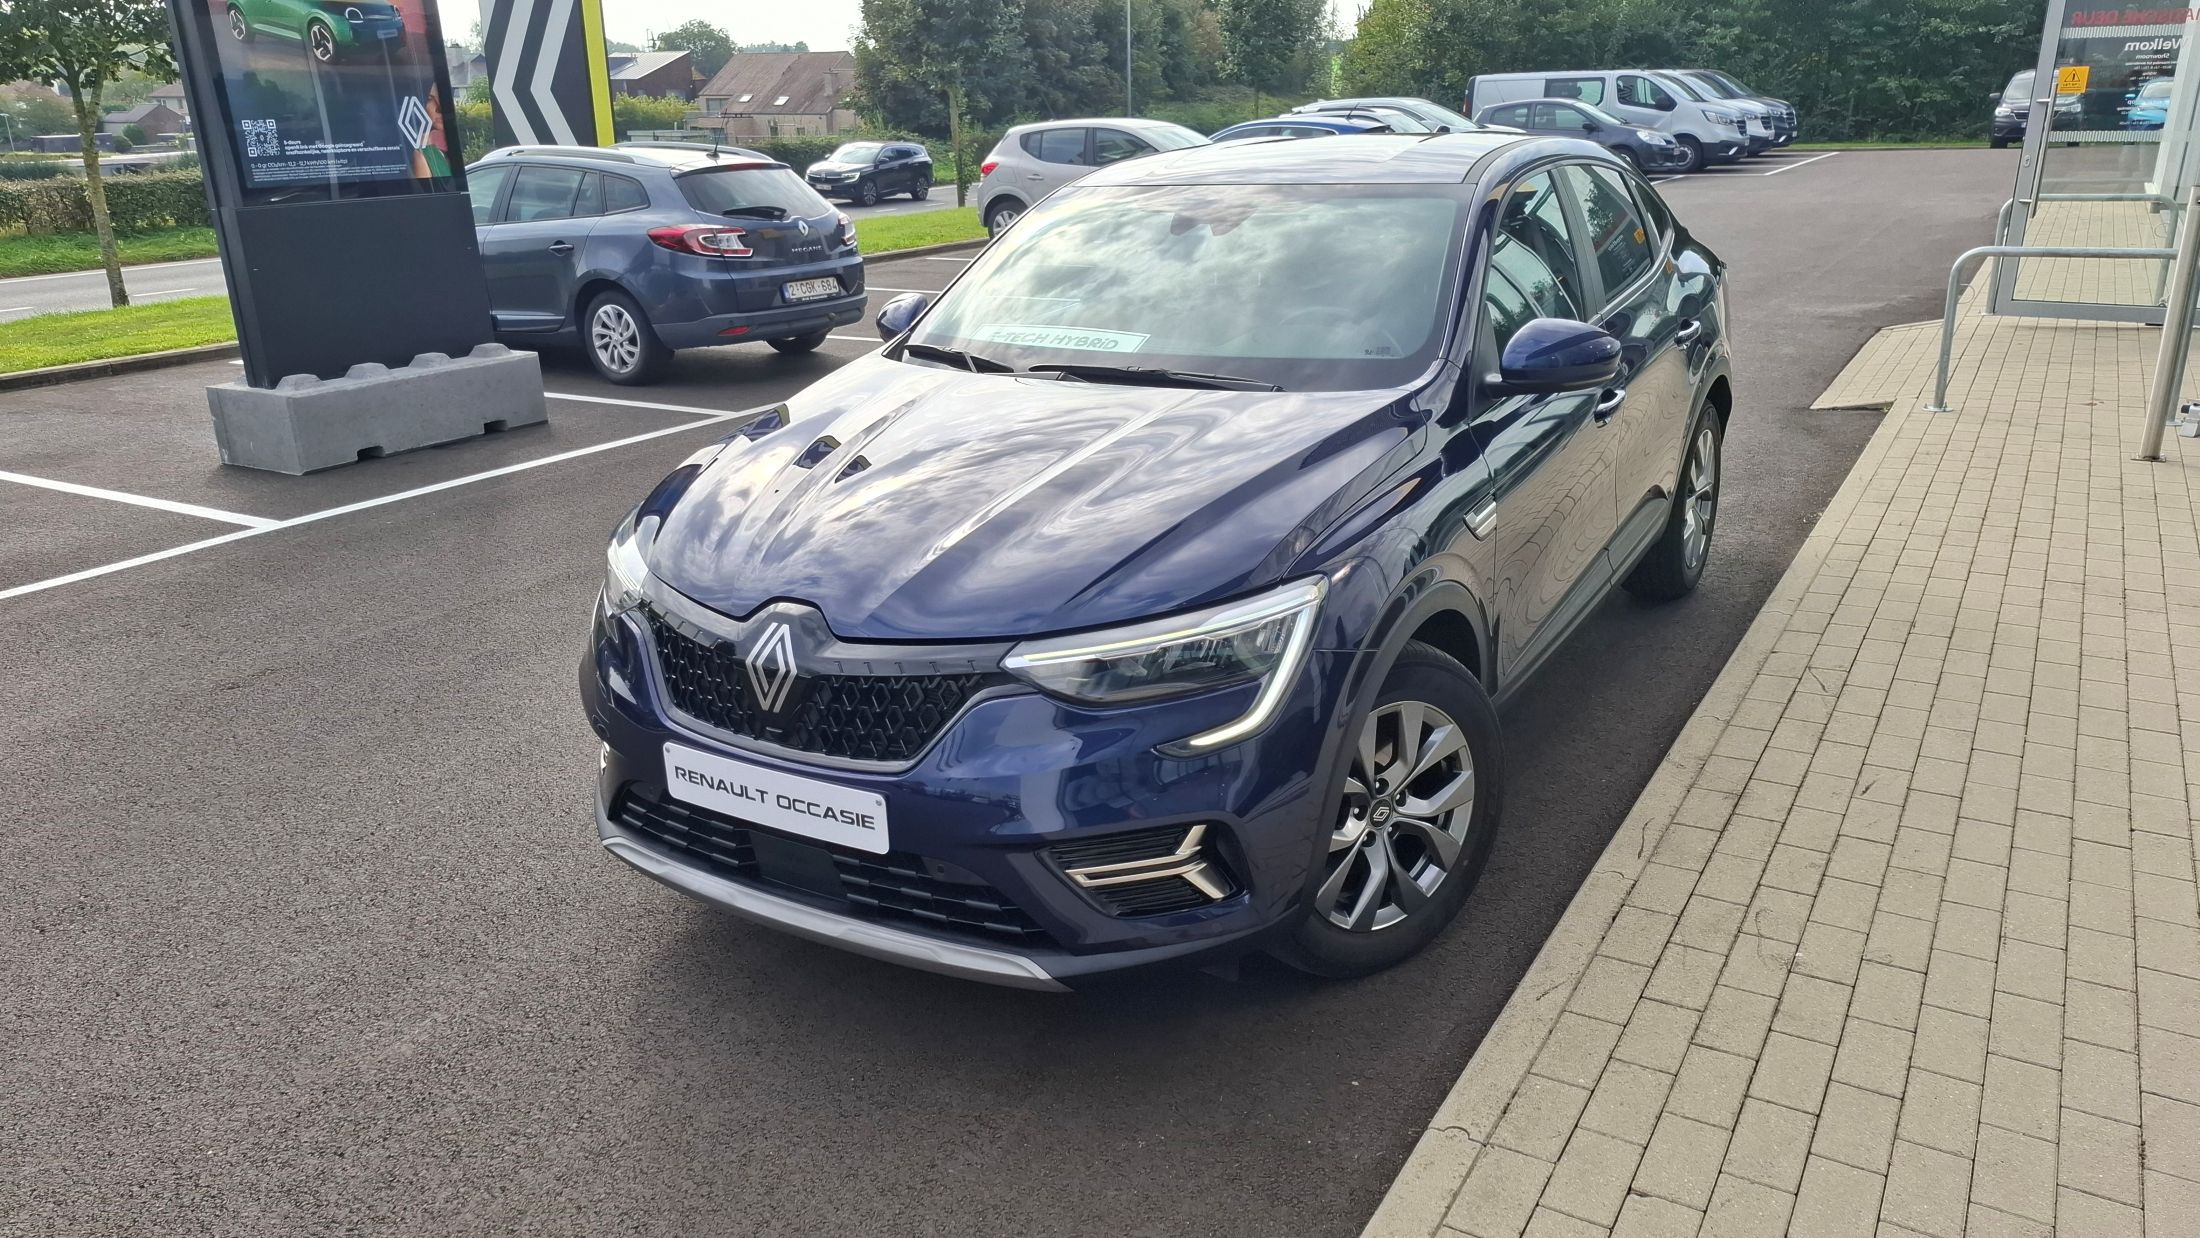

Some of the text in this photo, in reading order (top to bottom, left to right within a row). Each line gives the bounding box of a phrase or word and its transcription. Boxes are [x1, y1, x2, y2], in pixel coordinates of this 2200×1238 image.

[789, 278, 838, 296] 2-CGK-684
[674, 765, 876, 831] RENAULT OCCASIE
